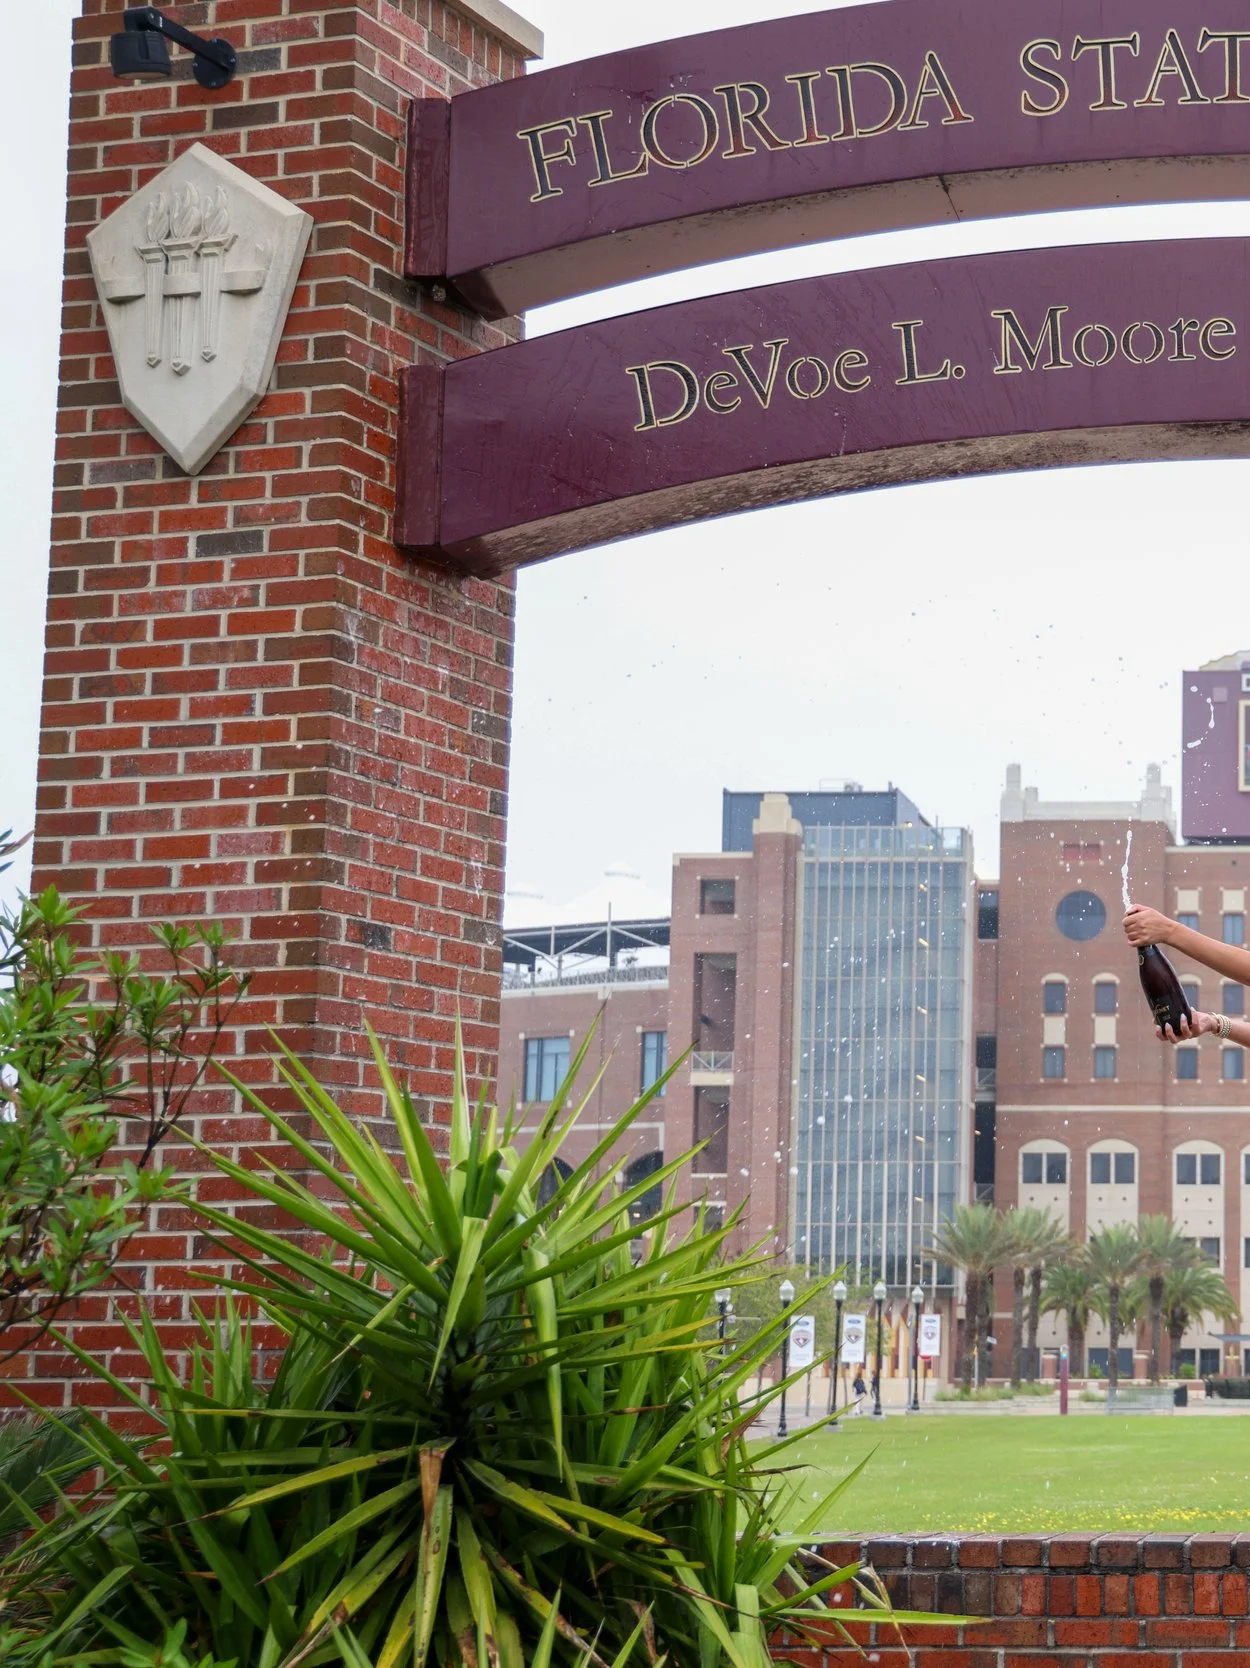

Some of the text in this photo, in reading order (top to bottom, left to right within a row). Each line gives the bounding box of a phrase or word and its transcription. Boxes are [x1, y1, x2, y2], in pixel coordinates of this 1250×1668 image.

[516, 50, 975, 203] FLORIDA
[624, 337, 871, 432] DeVoe
[892, 319, 966, 387] L.
[992, 304, 1238, 376] Moore
